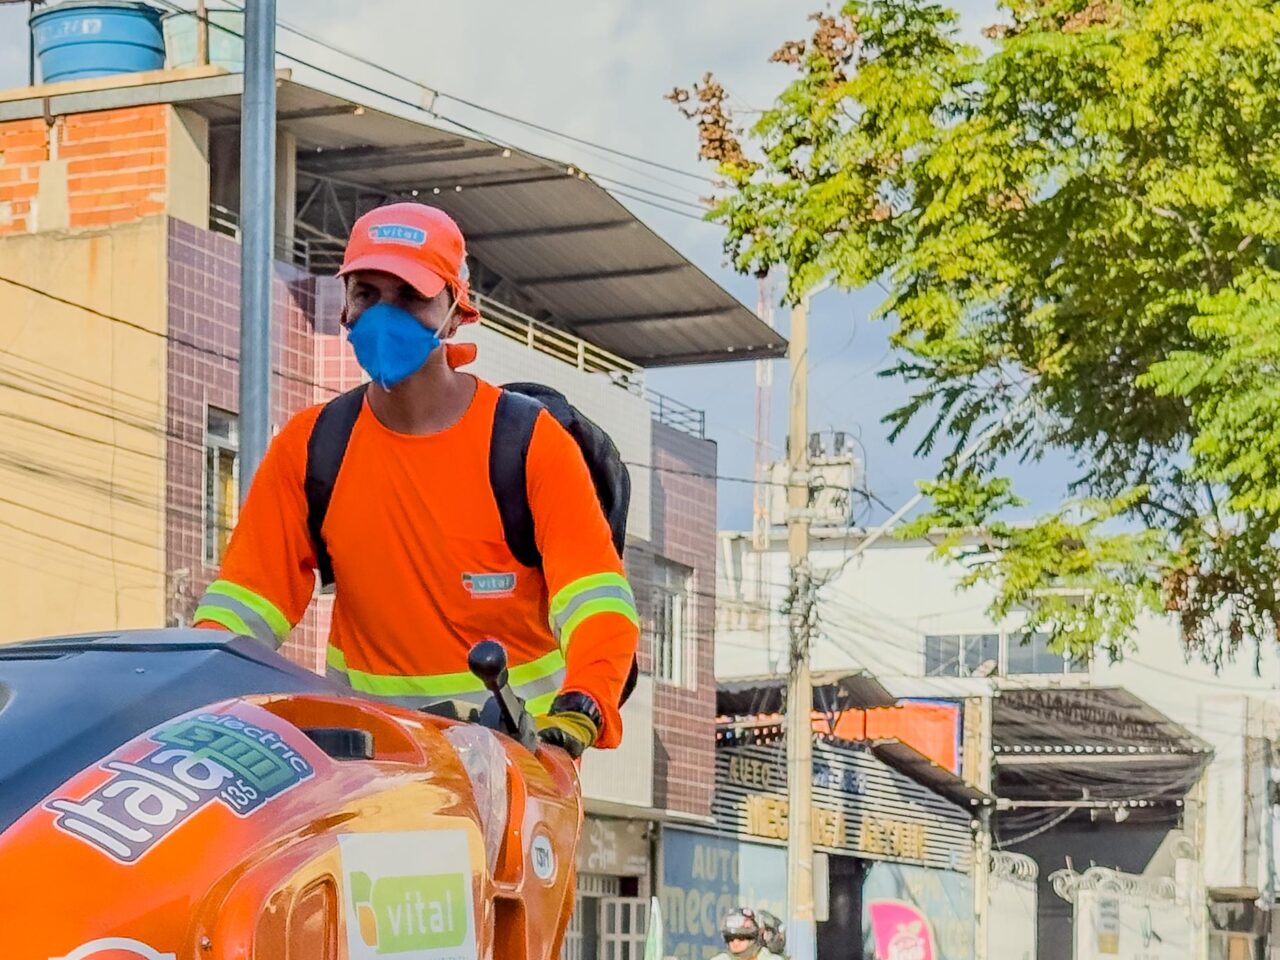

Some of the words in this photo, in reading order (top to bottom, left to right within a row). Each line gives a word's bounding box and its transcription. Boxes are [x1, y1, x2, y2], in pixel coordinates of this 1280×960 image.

[382, 227, 418, 239] vital
[198, 712, 309, 773] electric
[221, 779, 258, 810] 135
[386, 888, 455, 937] vital
